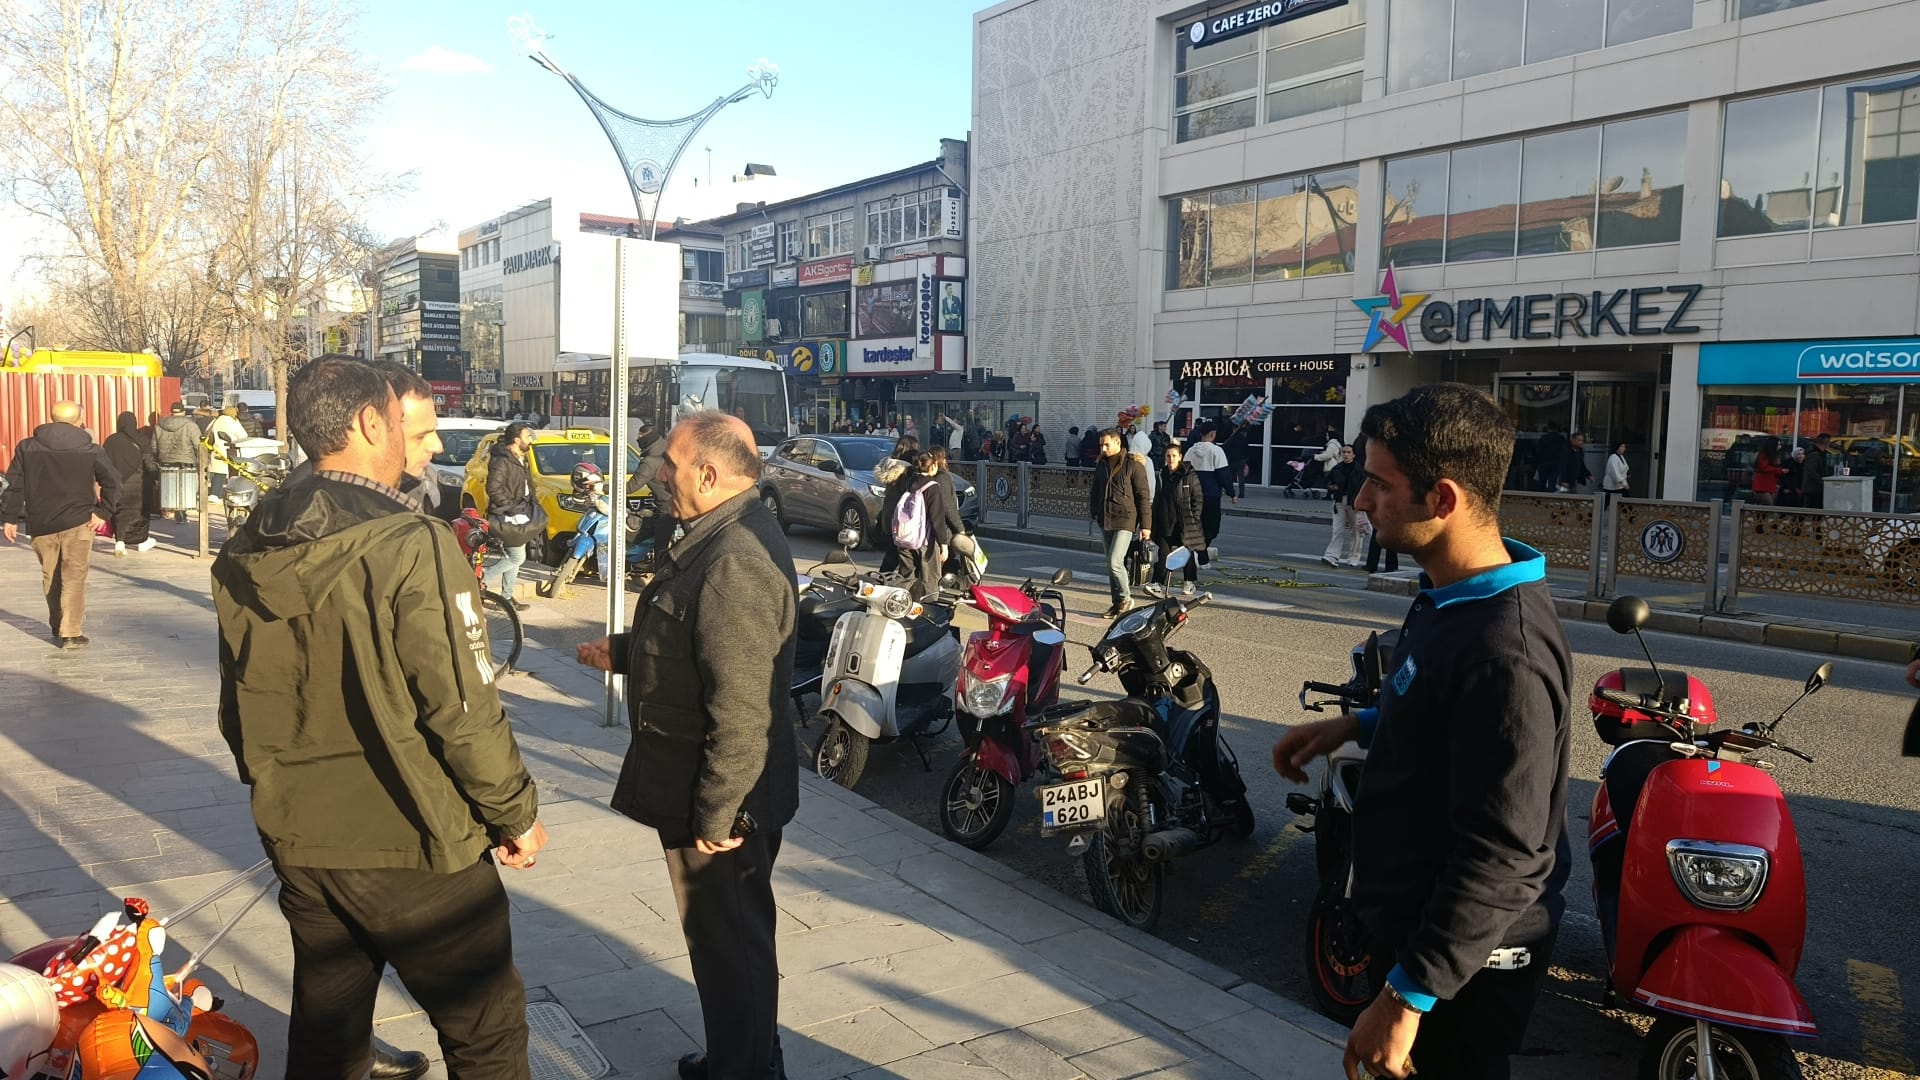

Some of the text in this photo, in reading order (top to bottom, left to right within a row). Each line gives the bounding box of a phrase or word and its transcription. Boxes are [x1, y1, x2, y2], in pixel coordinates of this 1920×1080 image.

[1212, 15, 1244, 34] CAFE
[1247, 1, 1282, 24] ZERO
[503, 245, 552, 275] PAULMARK
[920, 273, 931, 344] kardeşler
[863, 346, 914, 365] kardeşler
[1180, 360, 1334, 380] ARABICA COFFEE HOUSE
[512, 375, 544, 388] PAULMARK
[469, 641, 485, 650] adidas
[1046, 783, 1099, 807] 24ABJ
[1058, 805, 1089, 824] 620
